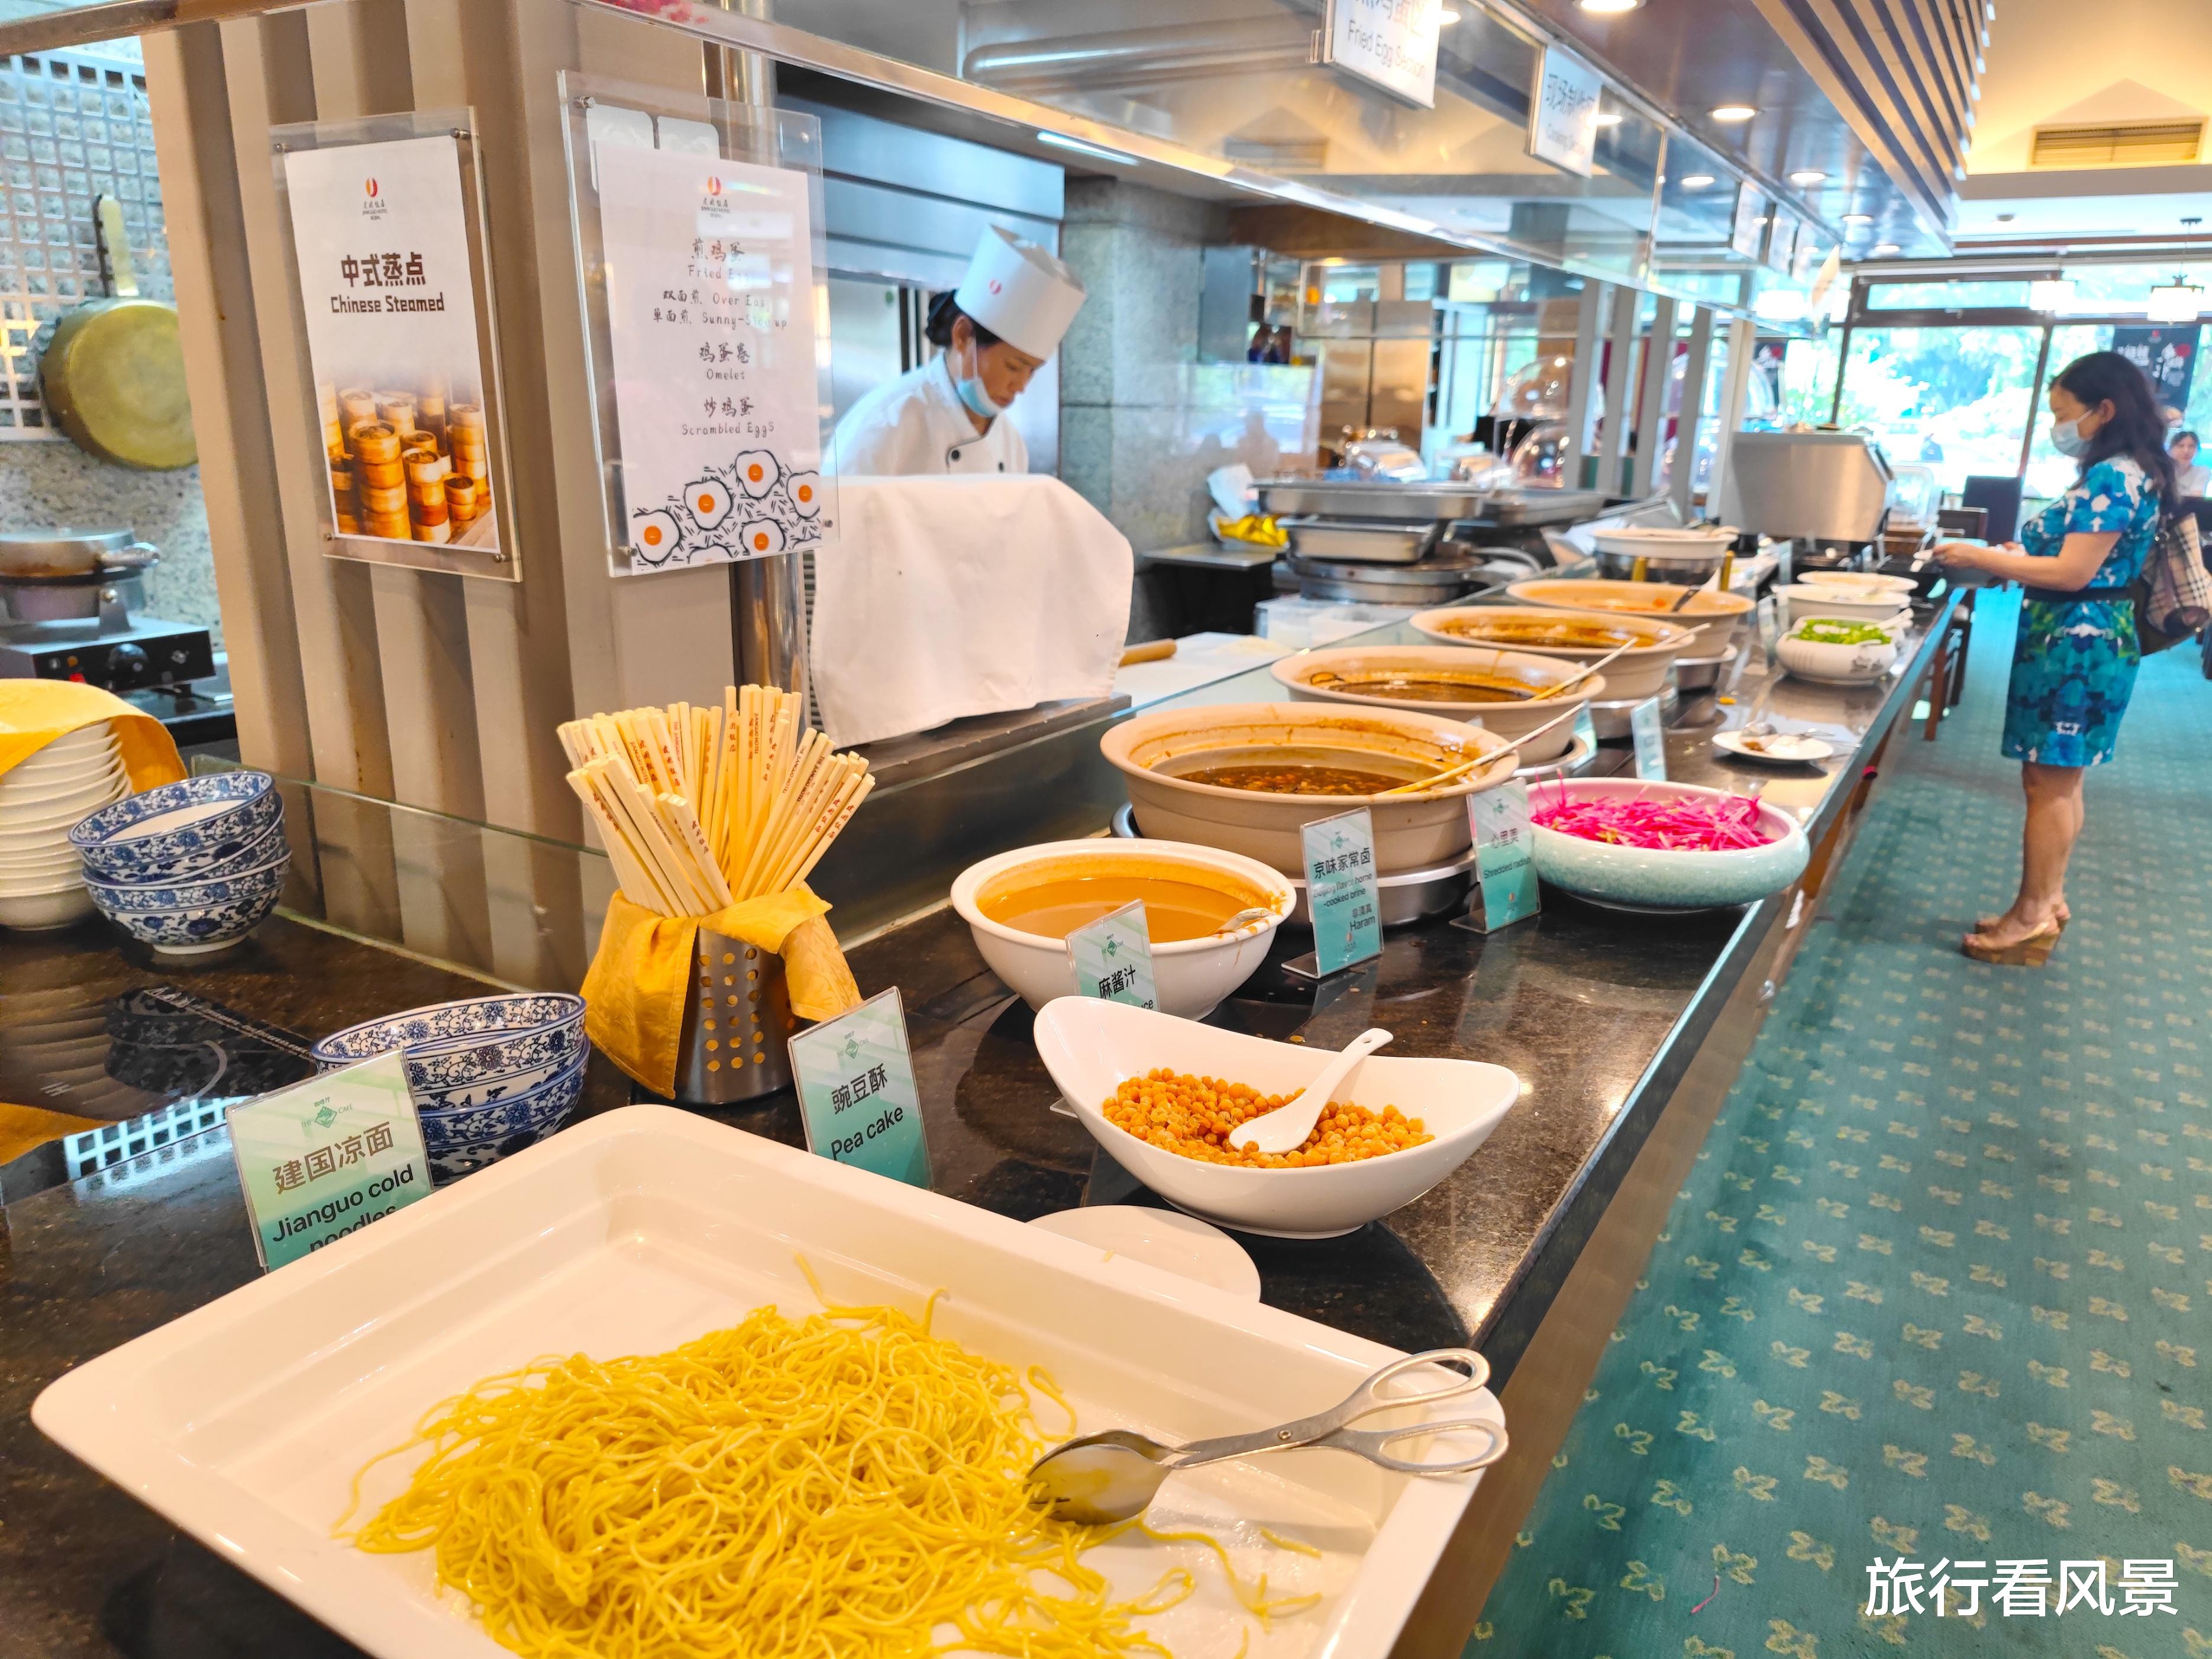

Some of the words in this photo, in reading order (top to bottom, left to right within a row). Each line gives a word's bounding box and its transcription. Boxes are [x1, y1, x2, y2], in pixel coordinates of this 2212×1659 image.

[1348, 20, 1374, 51] Fried
[1375, 34, 1393, 67] Egg
[691, 237, 744, 262] 煎鸡蛋
[341, 251, 426, 288] 中式蒸点
[688, 264, 722, 279] Fried
[331, 294, 382, 313] Chinese
[385, 292, 445, 312] Steamed
[663, 289, 703, 305] 双面煎
[713, 293, 740, 306] Over
[653, 307, 692, 324] 单面煎
[699, 341, 750, 363] 鸡蛋卷
[706, 369, 745, 380] Omelet
[703, 396, 754, 418] 炒鸡蛋
[682, 422, 741, 435] Scrambled
[1491, 828, 1519, 848] 心里美
[1313, 847, 1371, 879] 京味家常卤
[1483, 861, 1513, 879] Shredded
[1513, 856, 1531, 869] radish
[1355, 873, 1372, 884] home
[1350, 888, 1365, 899] brine
[1349, 916, 1375, 931] Haram
[1099, 964, 1136, 999] 麻酱汁
[831, 1063, 888, 1115] 豌豆酥
[831, 1131, 864, 1161] Pea
[867, 1106, 904, 1139] cake
[272, 1121, 394, 1195] 建国凉面
[273, 1190, 363, 1242] Jianguo
[368, 1163, 414, 1198] cold
